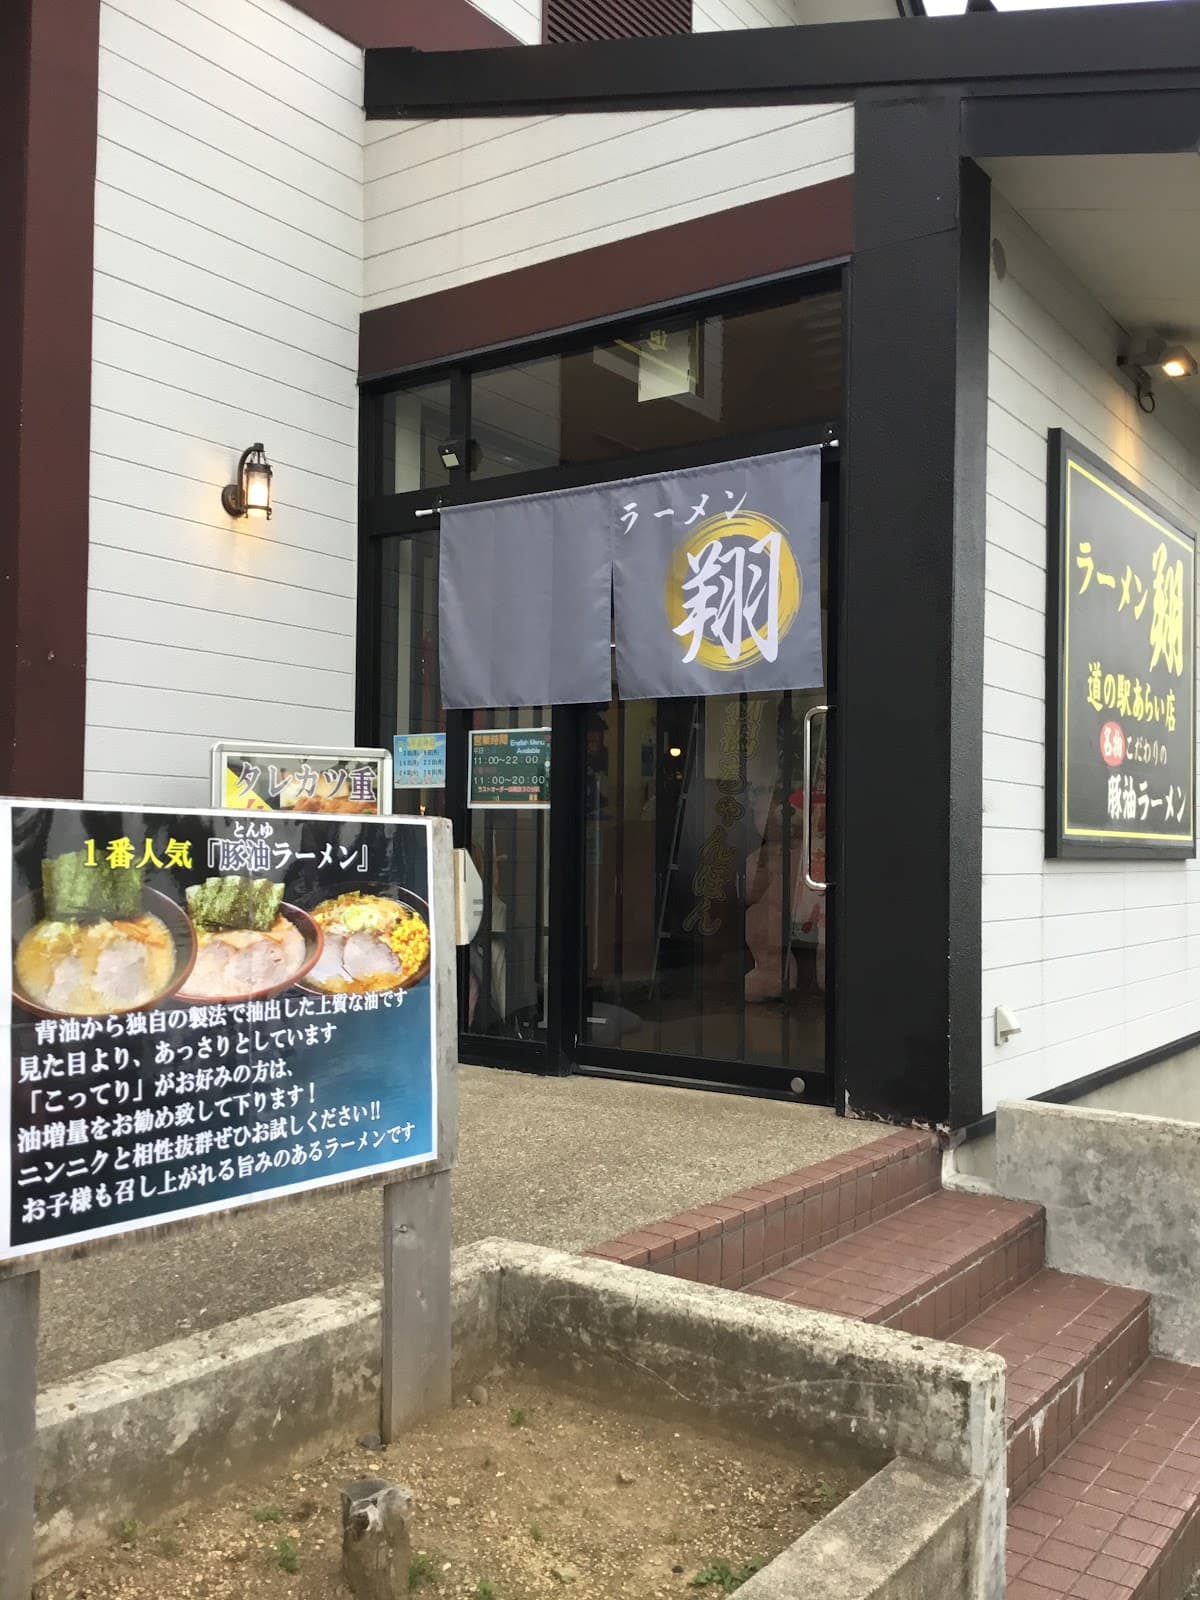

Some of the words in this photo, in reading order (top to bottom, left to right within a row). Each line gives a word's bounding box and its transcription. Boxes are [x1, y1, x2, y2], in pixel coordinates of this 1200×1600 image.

[619, 491, 748, 535] ラーメン
[672, 531, 783, 664] 翔
[1076, 542, 1185, 676] ラーメン翔
[1086, 661, 1177, 733] 道の駅あらい店
[1125, 737, 1168, 766] こだわりの
[236, 760, 377, 802] タレカツ重
[1107, 774, 1187, 824] 豚油ラーメン
[234, 822, 274, 838] とんゆ
[35, 988, 408, 1046] 背油から独自の製法で抽出した上質な油です
[19, 1022, 337, 1083] 見た目より、あっさりとしています
[30, 1058, 294, 1114] 「こってり」がお好みの方は、
[17, 1082, 317, 1153] 油増量をお勧め致して下ります！
[22, 1123, 416, 1223] お子様も召し上がれる旨みのあるラーメンです
